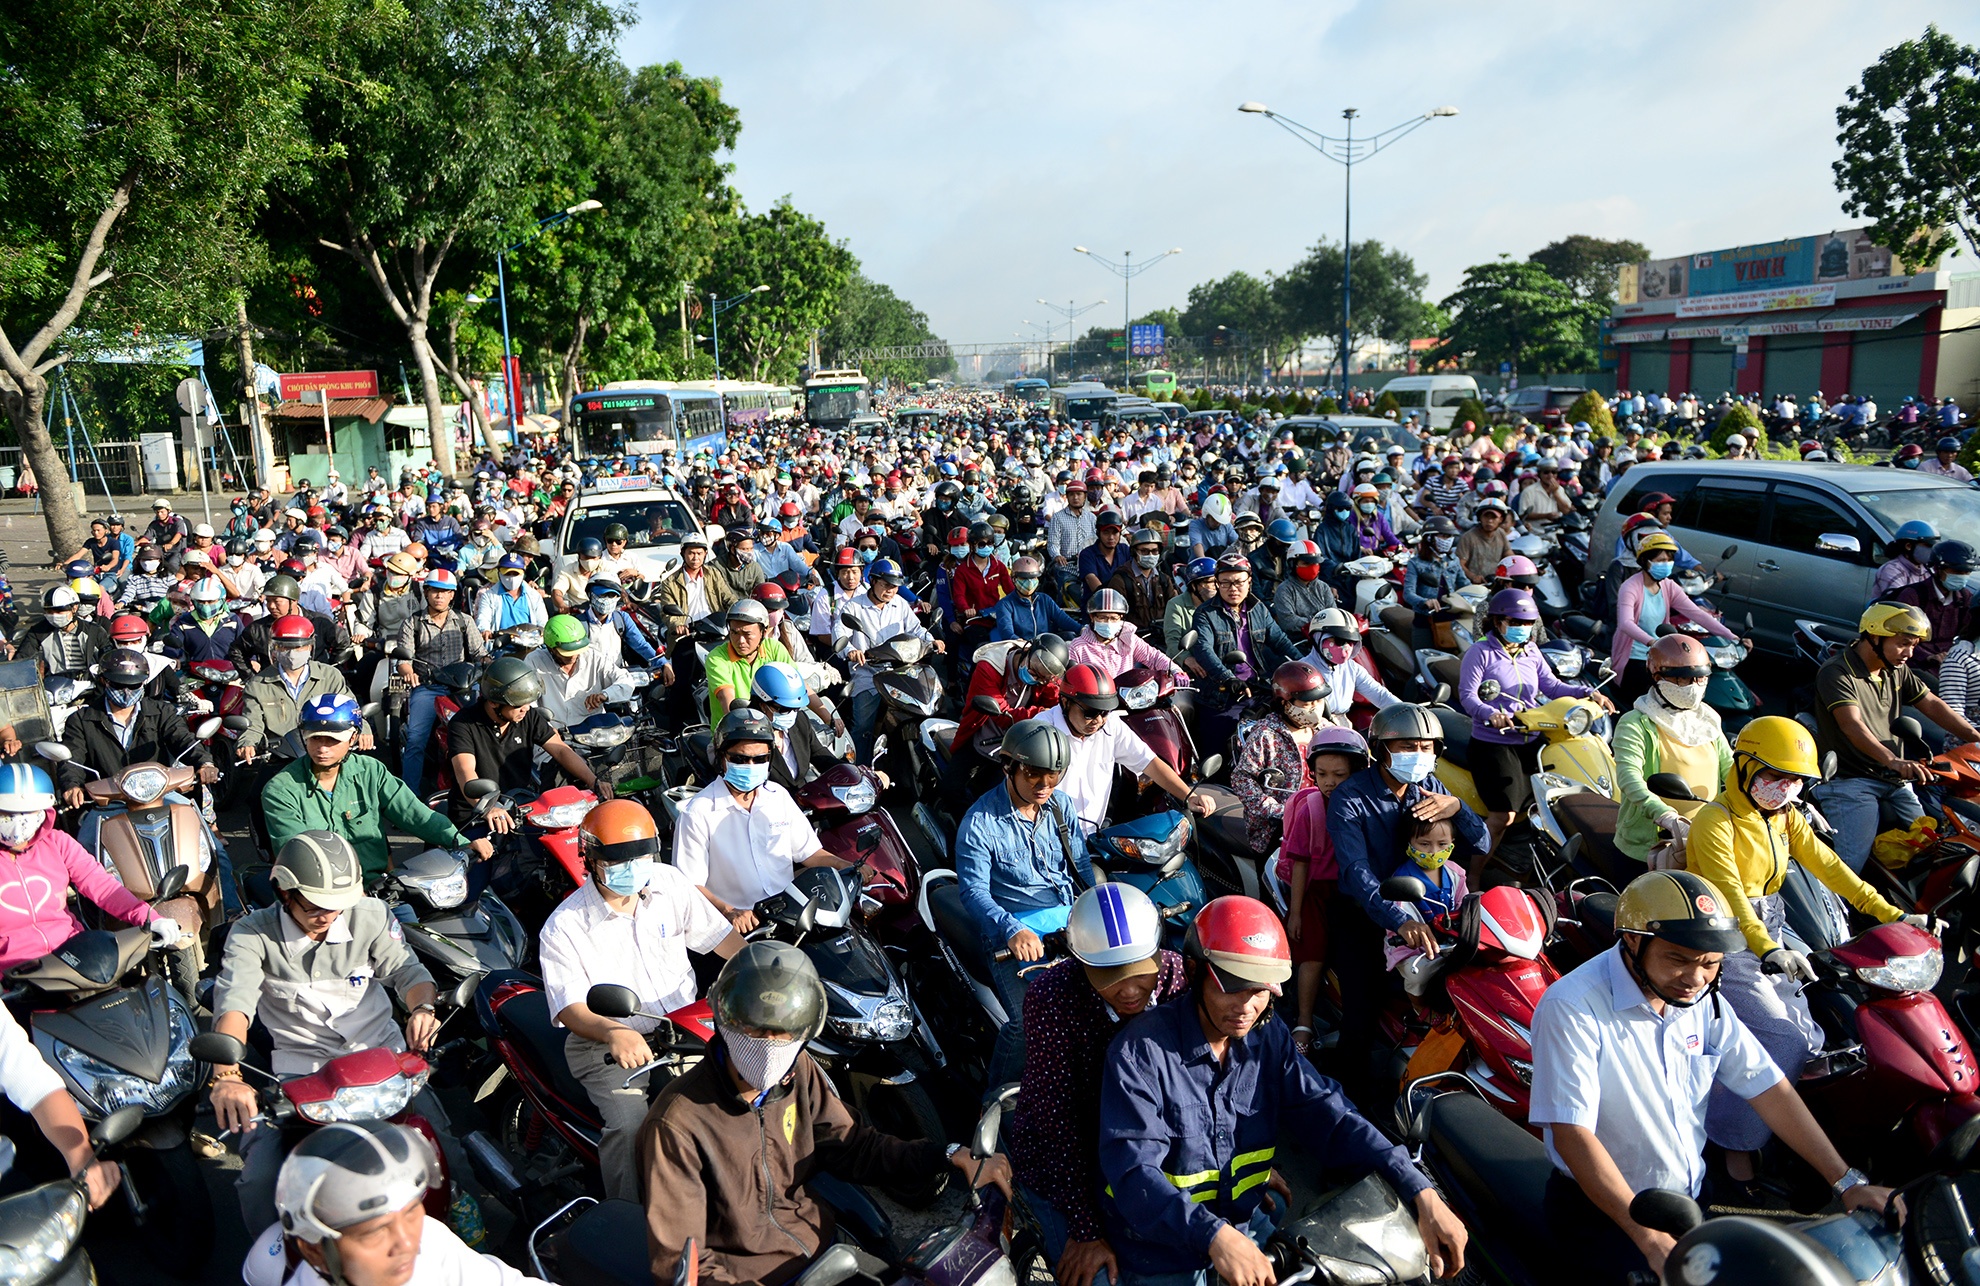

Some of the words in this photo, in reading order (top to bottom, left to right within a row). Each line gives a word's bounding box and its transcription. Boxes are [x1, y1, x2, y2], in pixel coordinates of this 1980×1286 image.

[1734, 256, 1786, 282] VINH
[1771, 323, 1798, 334] VINH
[1860, 318, 1893, 329] VINH
[1697, 327, 1719, 336] VINH
[340, 381, 354, 390] KHU
[600, 478, 619, 487] TAXI
[1519, 971, 1542, 981] HONDA
